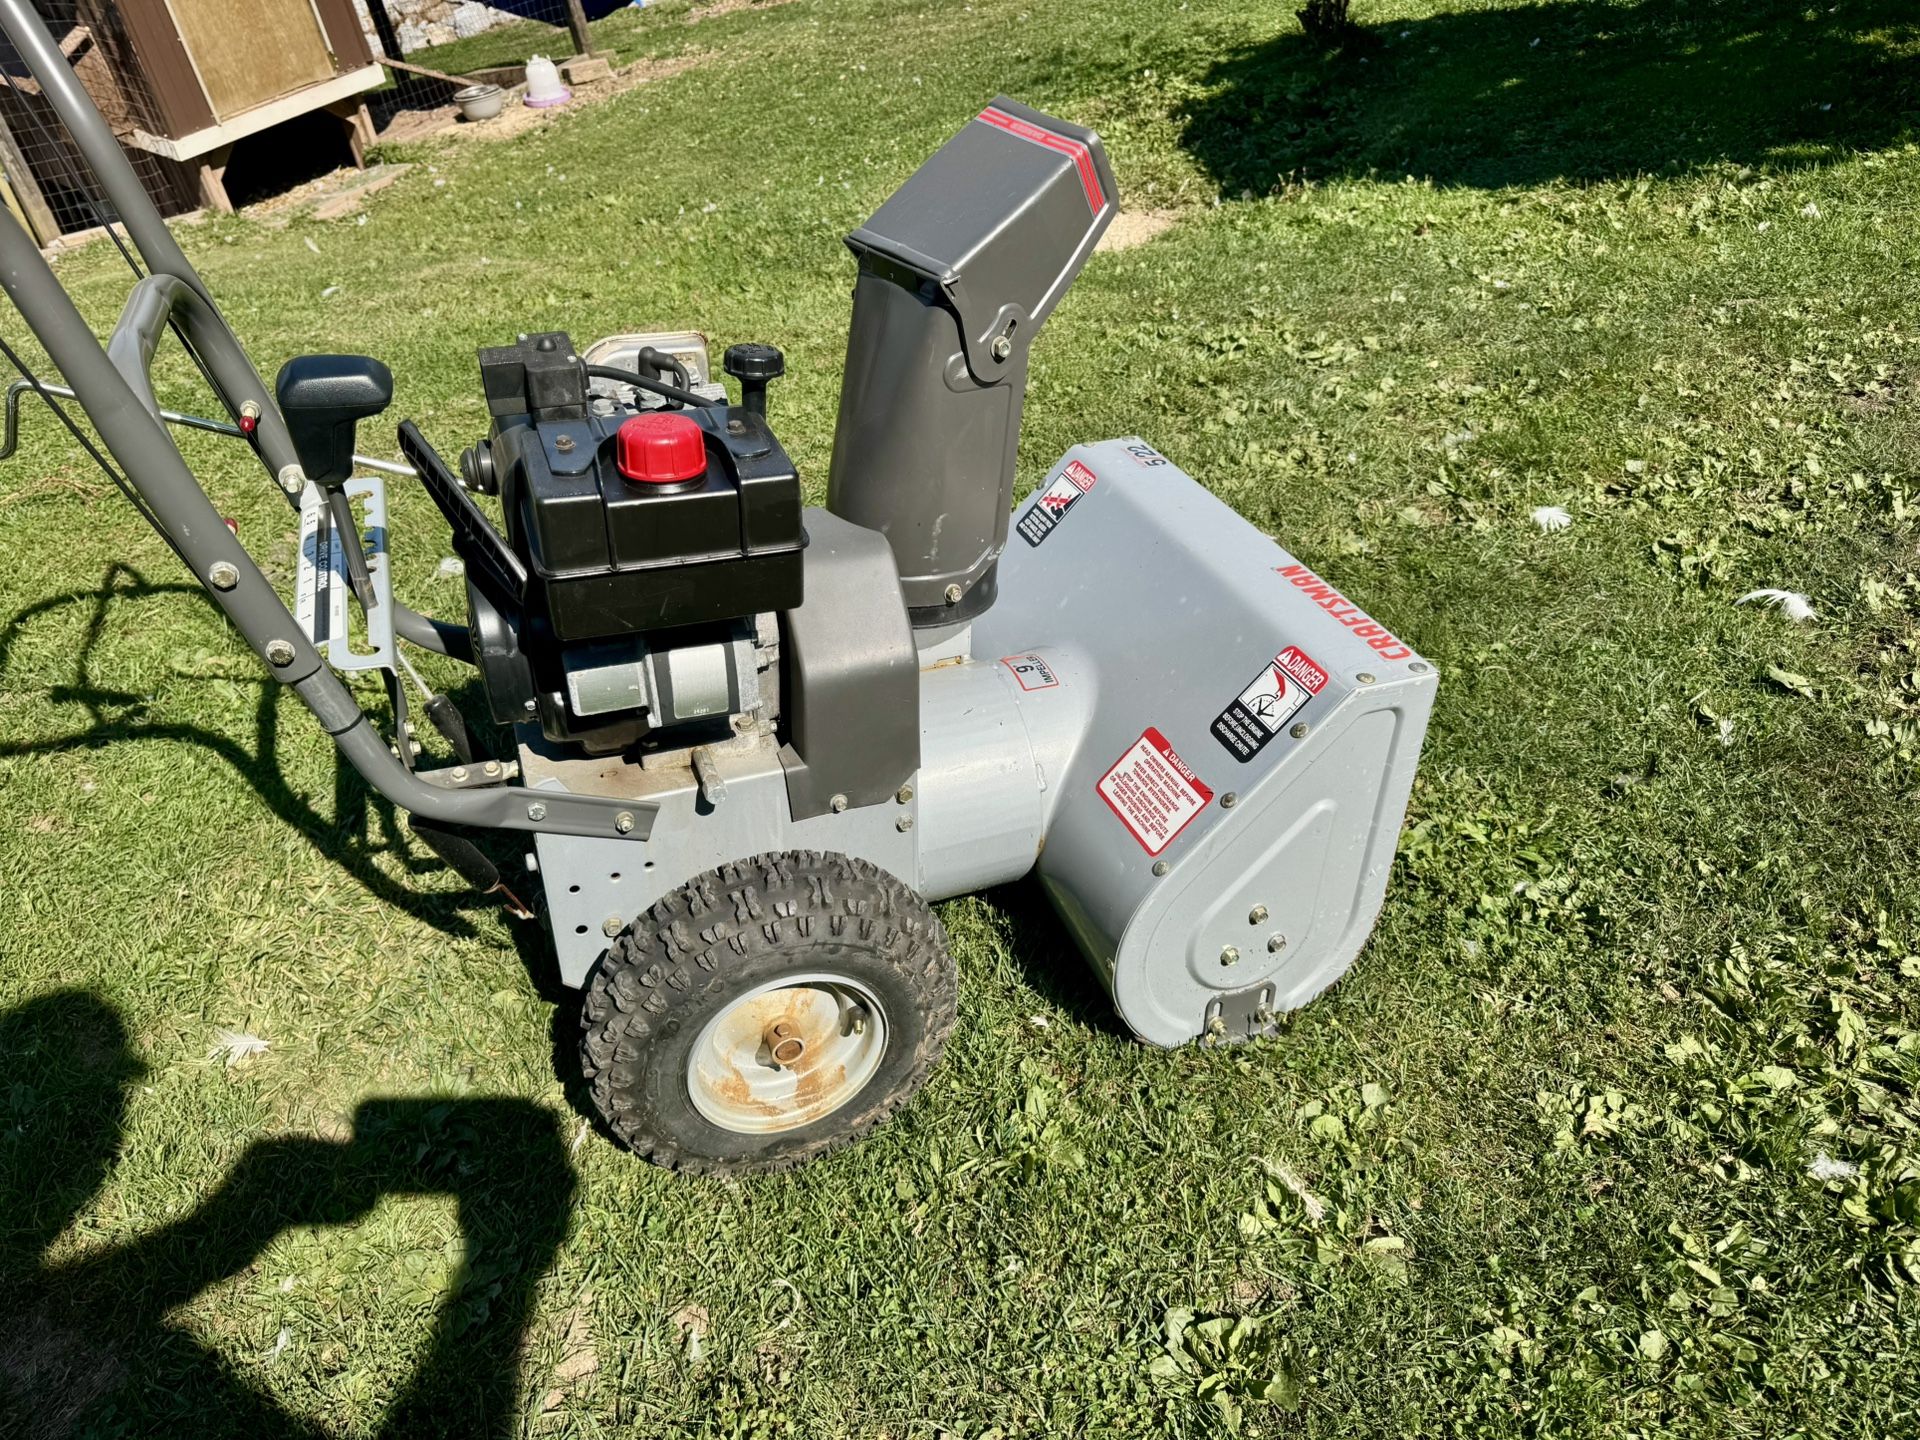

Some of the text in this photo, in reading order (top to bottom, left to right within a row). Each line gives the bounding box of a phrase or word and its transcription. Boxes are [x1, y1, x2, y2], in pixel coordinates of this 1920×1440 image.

[1070, 466, 1095, 490] DANGER
[316, 541, 328, 592] DRIVE CONTROL
[1276, 565, 1412, 660] CRAFTSMAN
[1287, 655, 1325, 691] DANGER
[1216, 721, 1238, 744] DISCHARGE
[1222, 712, 1260, 750] BEFORE UNCLOGGING
[1232, 707, 1264, 738] STOP THE ENGINE
[1131, 768, 1149, 788] TOWARDS
[1133, 760, 1180, 812] NEVER DIRECT DISCHARGE
[1140, 744, 1196, 806] READ OWNERS MANUAL BEFORE
[1143, 758, 1182, 800] OPERATING MACHINE.
[1168, 753, 1196, 783] DANGER
[1109, 775, 1166, 841] OR AUGER HOUSING AND BEFORE
[1112, 789, 1152, 835] LEAVING THE MACHINE.
[1114, 771, 1169, 835] UNCLOGGING DISCHARGE CHUTE
[1122, 772, 1169, 824] STOP THE ENGINE BEFORE
